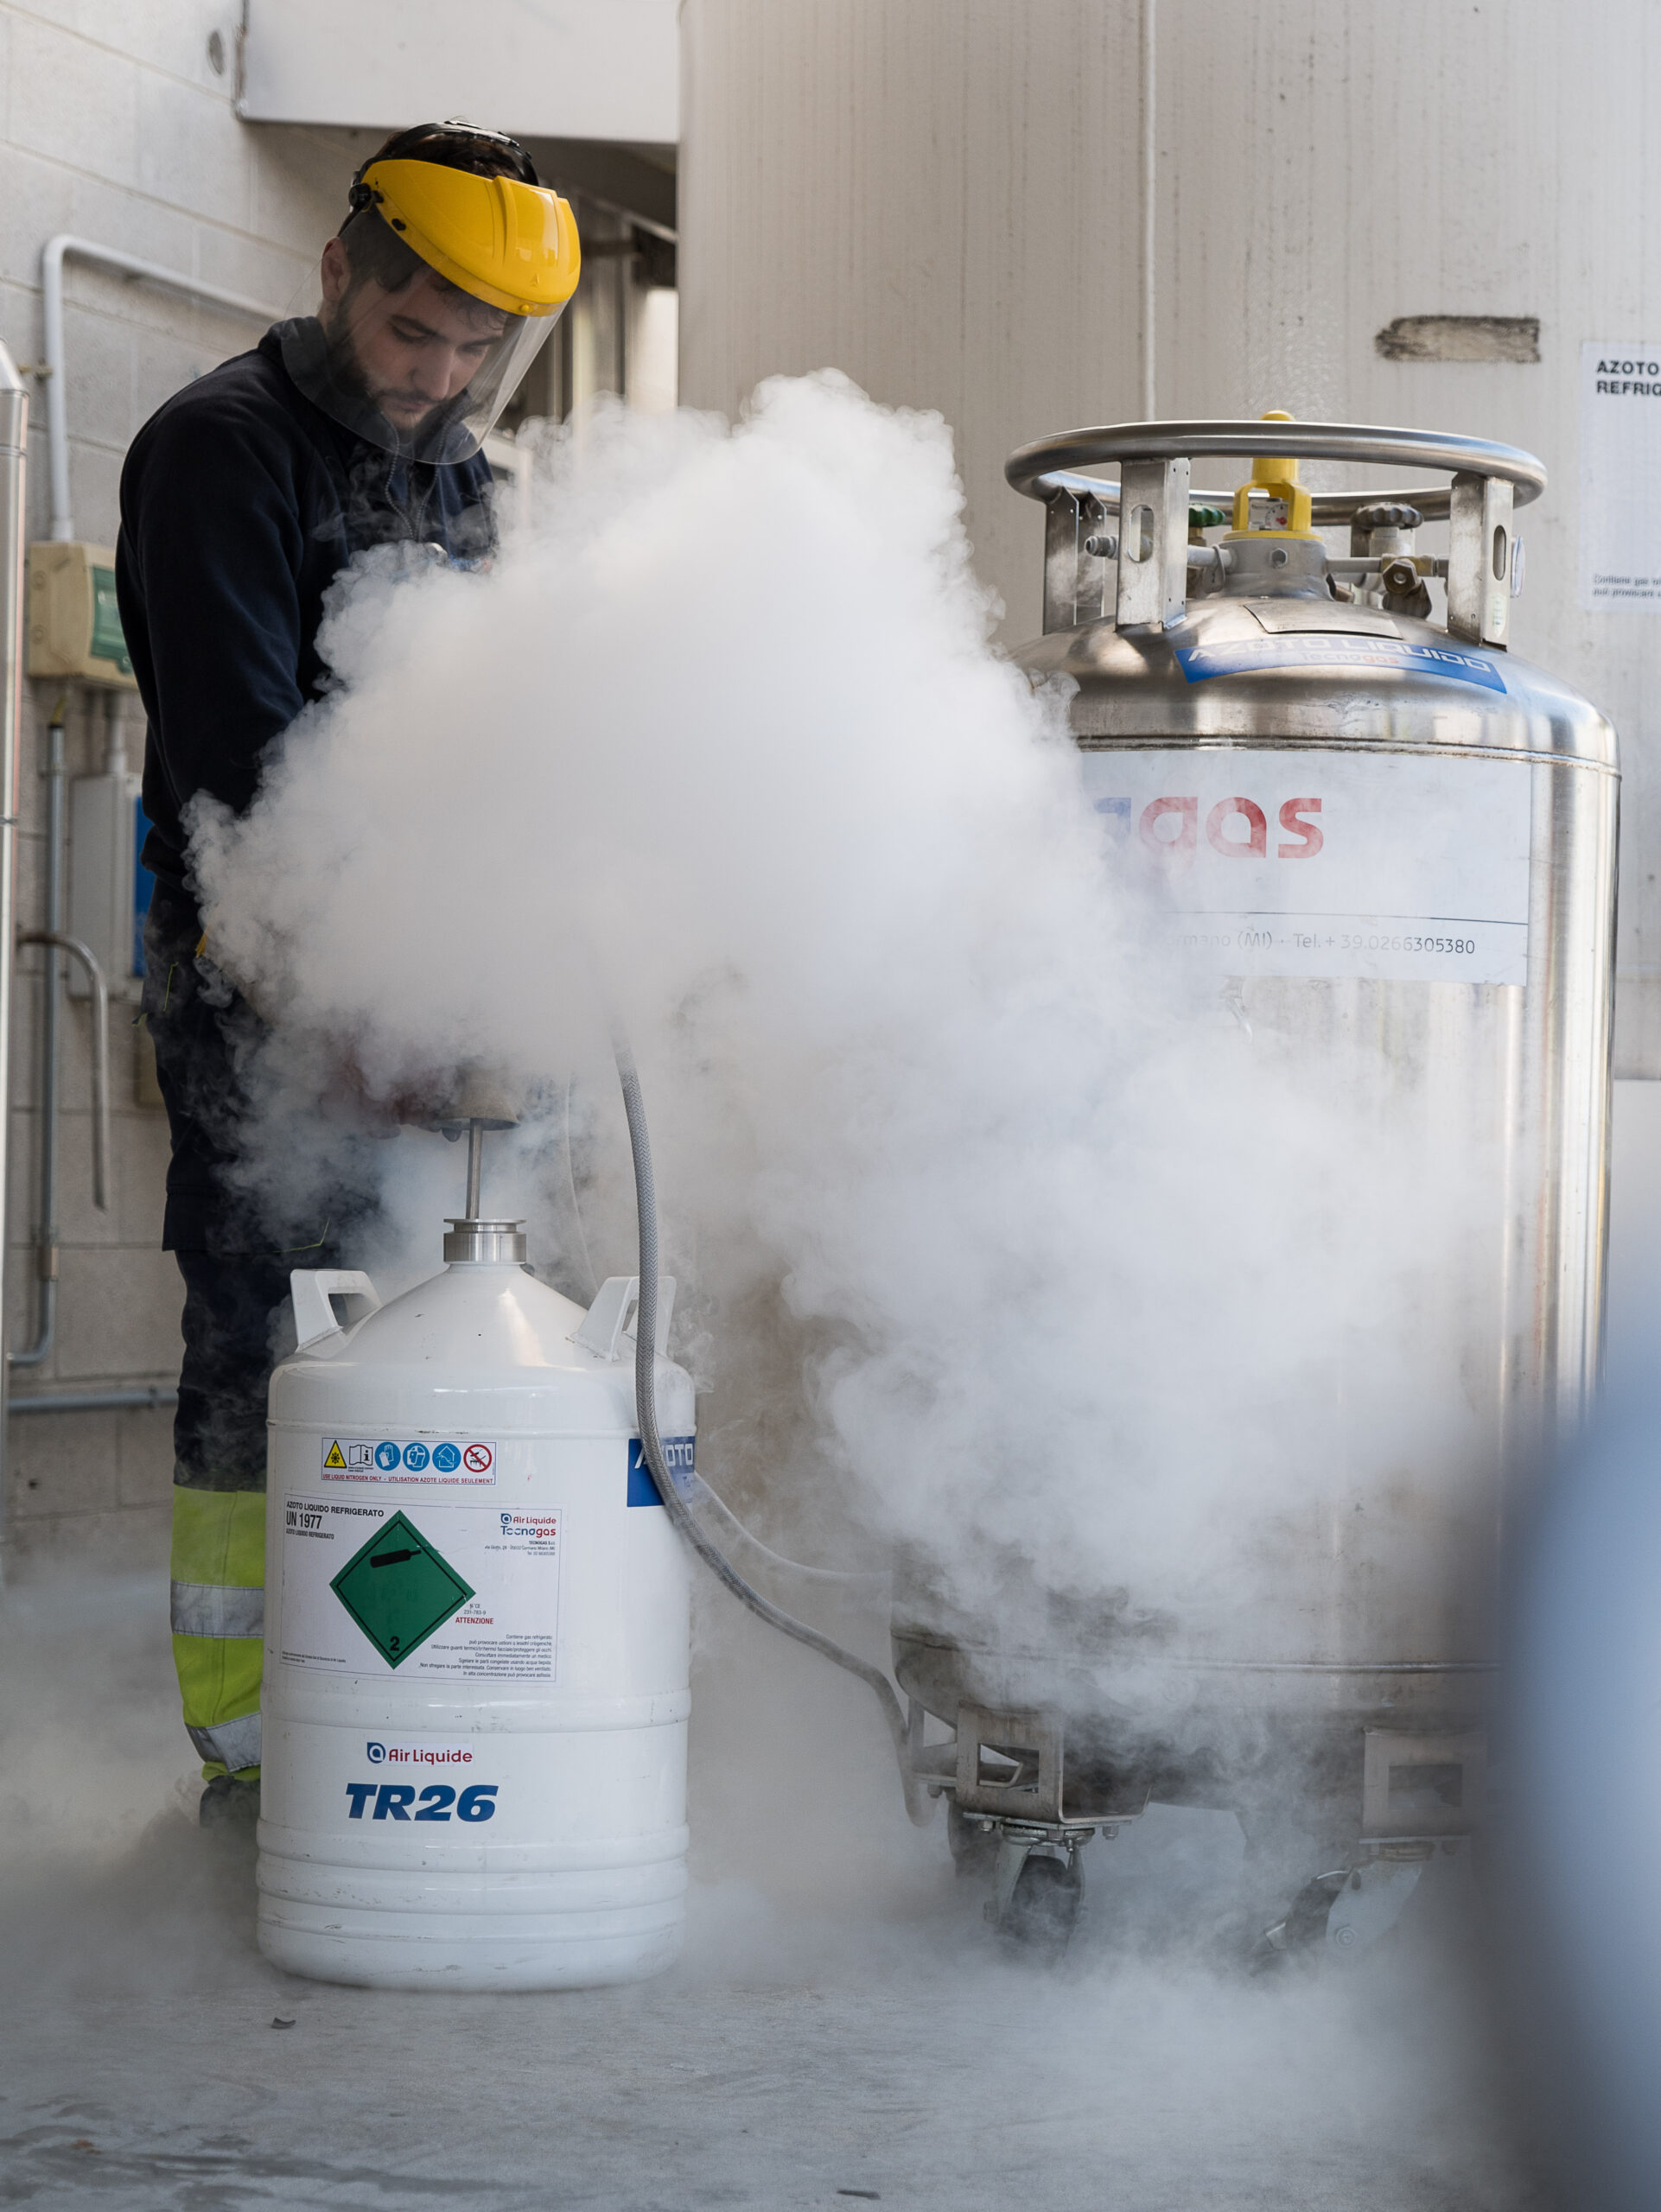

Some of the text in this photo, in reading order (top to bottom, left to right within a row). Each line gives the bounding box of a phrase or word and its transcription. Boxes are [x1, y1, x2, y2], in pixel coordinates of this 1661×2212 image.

[1596, 359, 1659, 376] AZOTO
[1187, 638, 1492, 672] AZOTO LIQUIDO
[1237, 931, 1273, 950] (MI)
[286, 1501, 385, 1517] AZOTO LIQUIDO REFRIGERATO
[286, 1510, 322, 1529] UN 1977
[525, 1516, 557, 1525] Liquide
[390, 1636, 400, 1651] 2
[389, 1748, 473, 1765] Air Liquide
[345, 1783, 500, 1822] TR26
